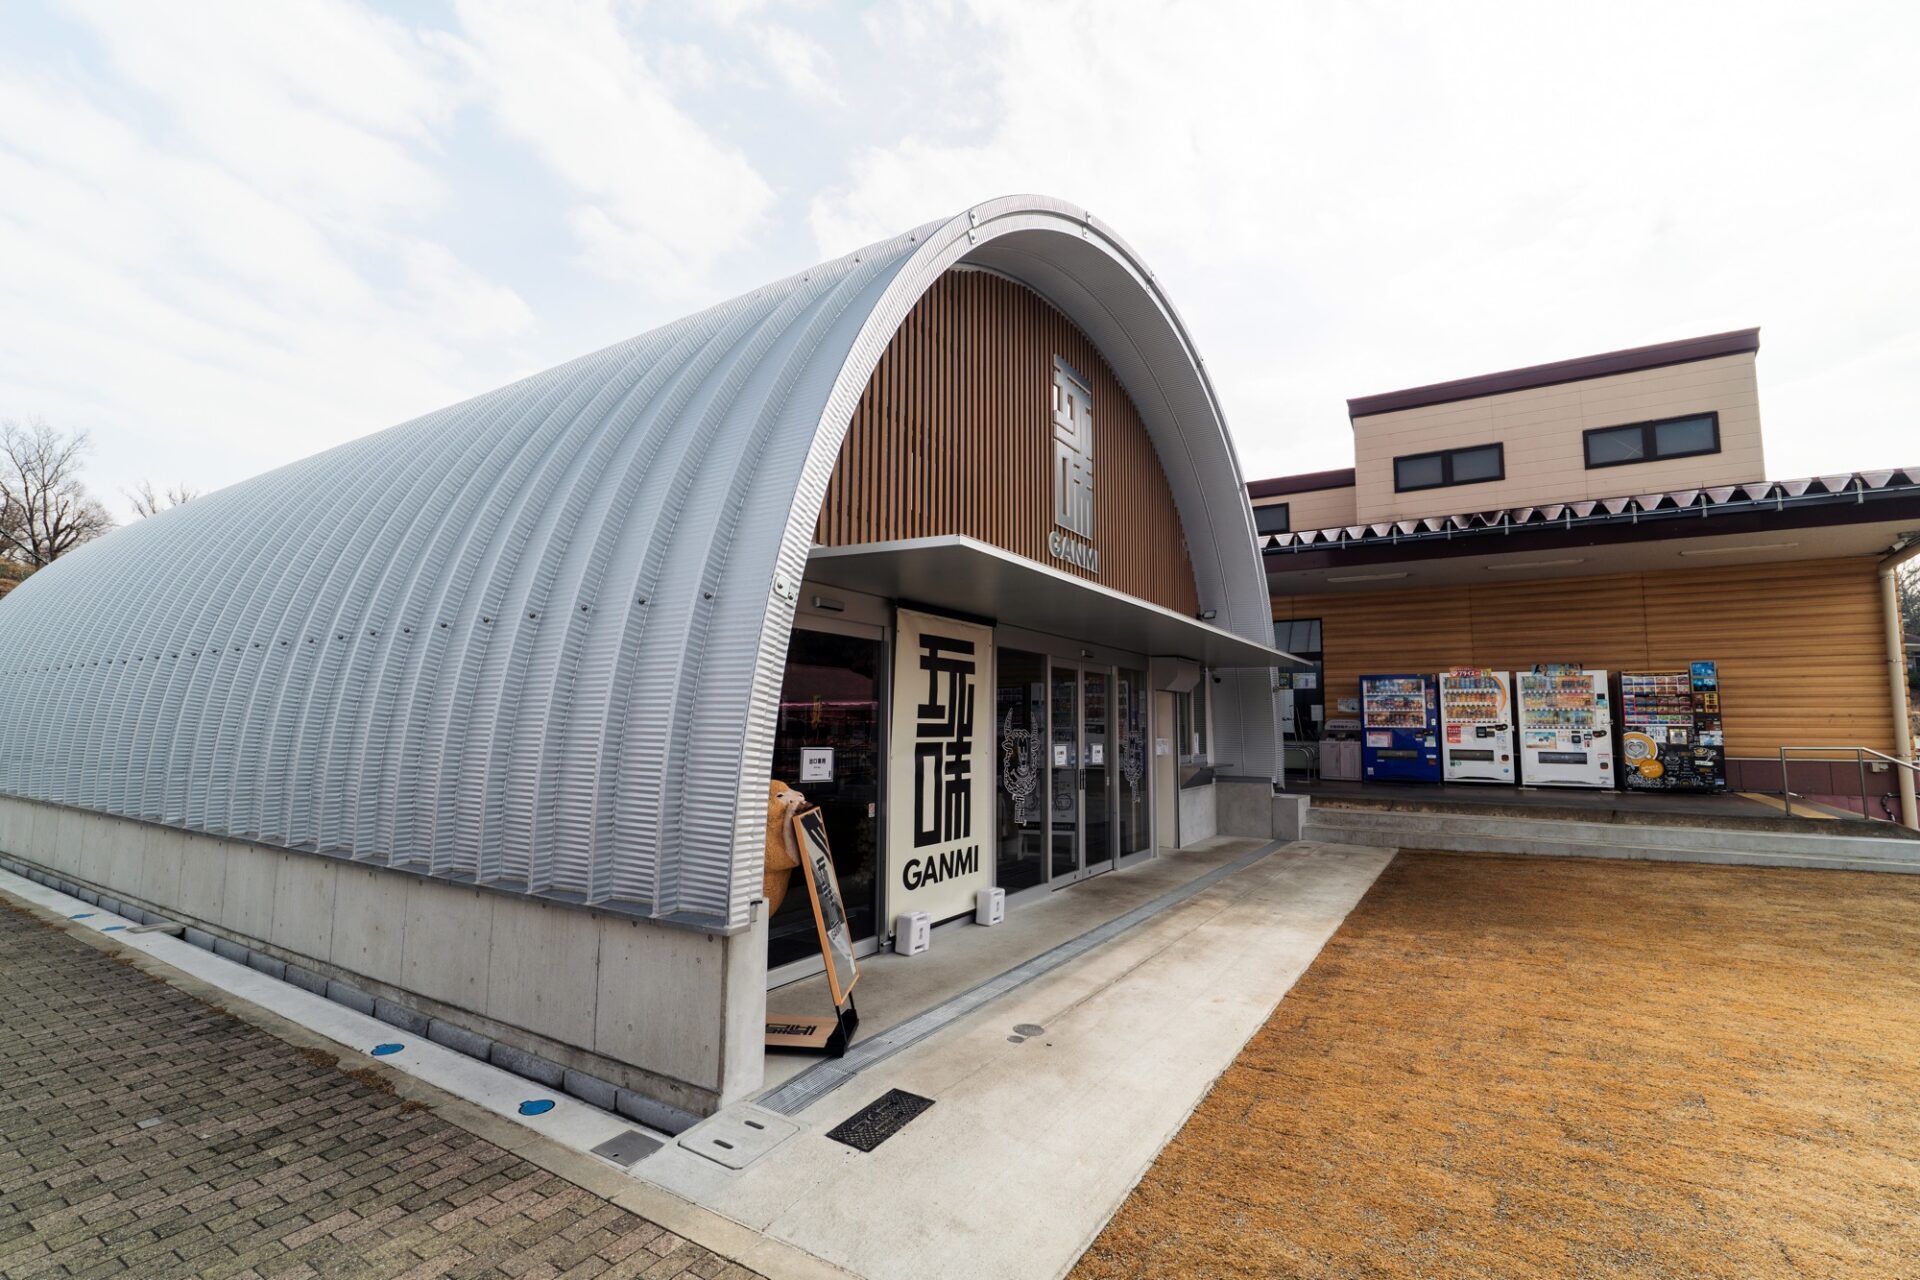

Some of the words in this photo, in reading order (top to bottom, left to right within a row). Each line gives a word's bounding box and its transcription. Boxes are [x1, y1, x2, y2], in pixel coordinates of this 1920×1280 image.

[1049, 532, 1098, 572] GANMI
[914, 633, 976, 849] 玩味
[902, 845, 979, 891] GANMI
